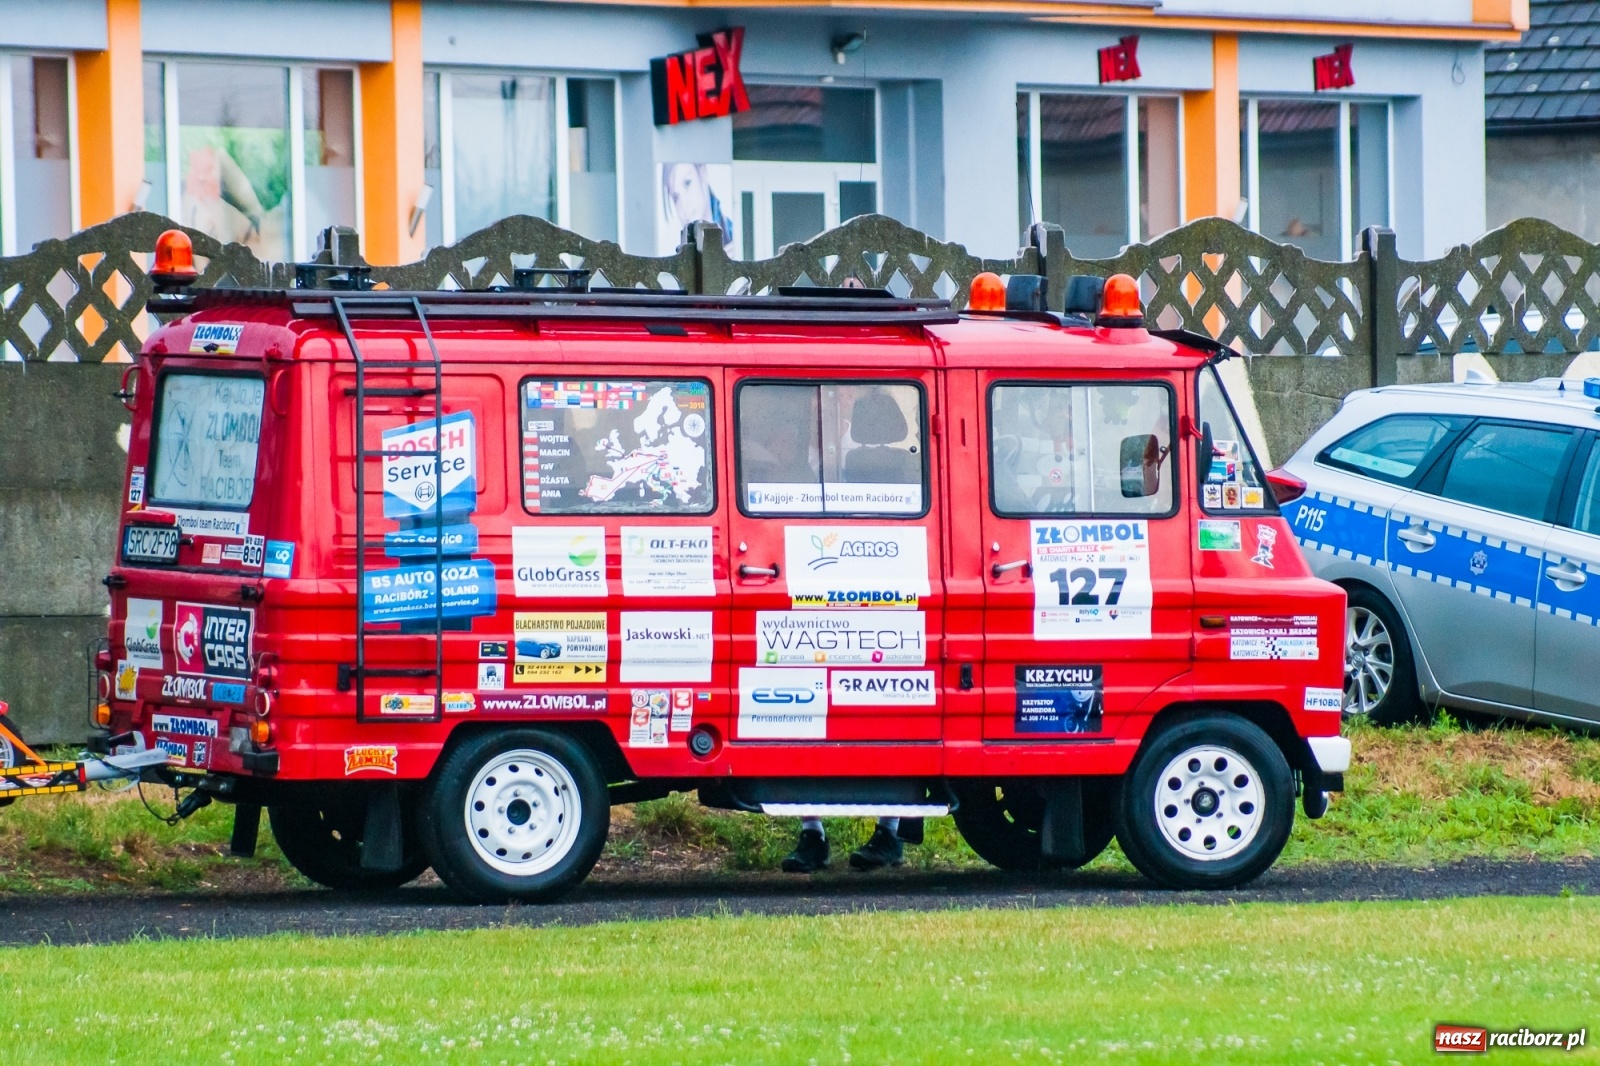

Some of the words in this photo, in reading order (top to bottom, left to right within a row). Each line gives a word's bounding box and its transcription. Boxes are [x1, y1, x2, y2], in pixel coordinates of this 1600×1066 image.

[1099, 34, 1142, 84] NEX
[1314, 43, 1355, 91] NEX
[663, 25, 752, 126] NEX
[387, 428, 465, 462] BOSCH
[539, 434, 569, 444] WOJTEK
[539, 449, 570, 457] MARCIN
[388, 456, 465, 483] Service
[540, 475, 570, 485] DŻASTA
[541, 490, 562, 498] ANIA
[764, 493, 794, 504] Kajjoje
[801, 493, 839, 503] Złombol
[840, 494, 864, 502] team
[866, 493, 904, 503] Racibórz
[1294, 504, 1327, 531] P115
[1035, 523, 1144, 545] ZŁOMBOL
[129, 530, 149, 553] SRC
[151, 530, 177, 556] 2F98
[650, 539, 709, 549] OLT-EKO
[840, 540, 899, 557] AGROS
[371, 576, 392, 589] BS
[394, 570, 435, 587] AUTO
[517, 567, 600, 582] GlobGrass
[374, 588, 429, 604] RACIBÓRZ
[441, 584, 479, 597] OLAND
[1049, 567, 1127, 605] 127
[795, 590, 916, 603] www.ZŁOMBOL.pl
[204, 616, 247, 643] INTER
[515, 620, 564, 630] BLACHARSTWO
[566, 620, 605, 630] POJAZDOWE
[762, 616, 850, 633] wydawnictwo
[566, 635, 592, 643] NAPRAWY
[762, 630, 921, 650] WAGTECH
[204, 643, 247, 670] CARS
[566, 644, 606, 652] POWYPADKOWE
[1026, 669, 1093, 682] KRZYCHU
[838, 678, 930, 692] GRAVTON
[751, 714, 813, 723] Personalservice
